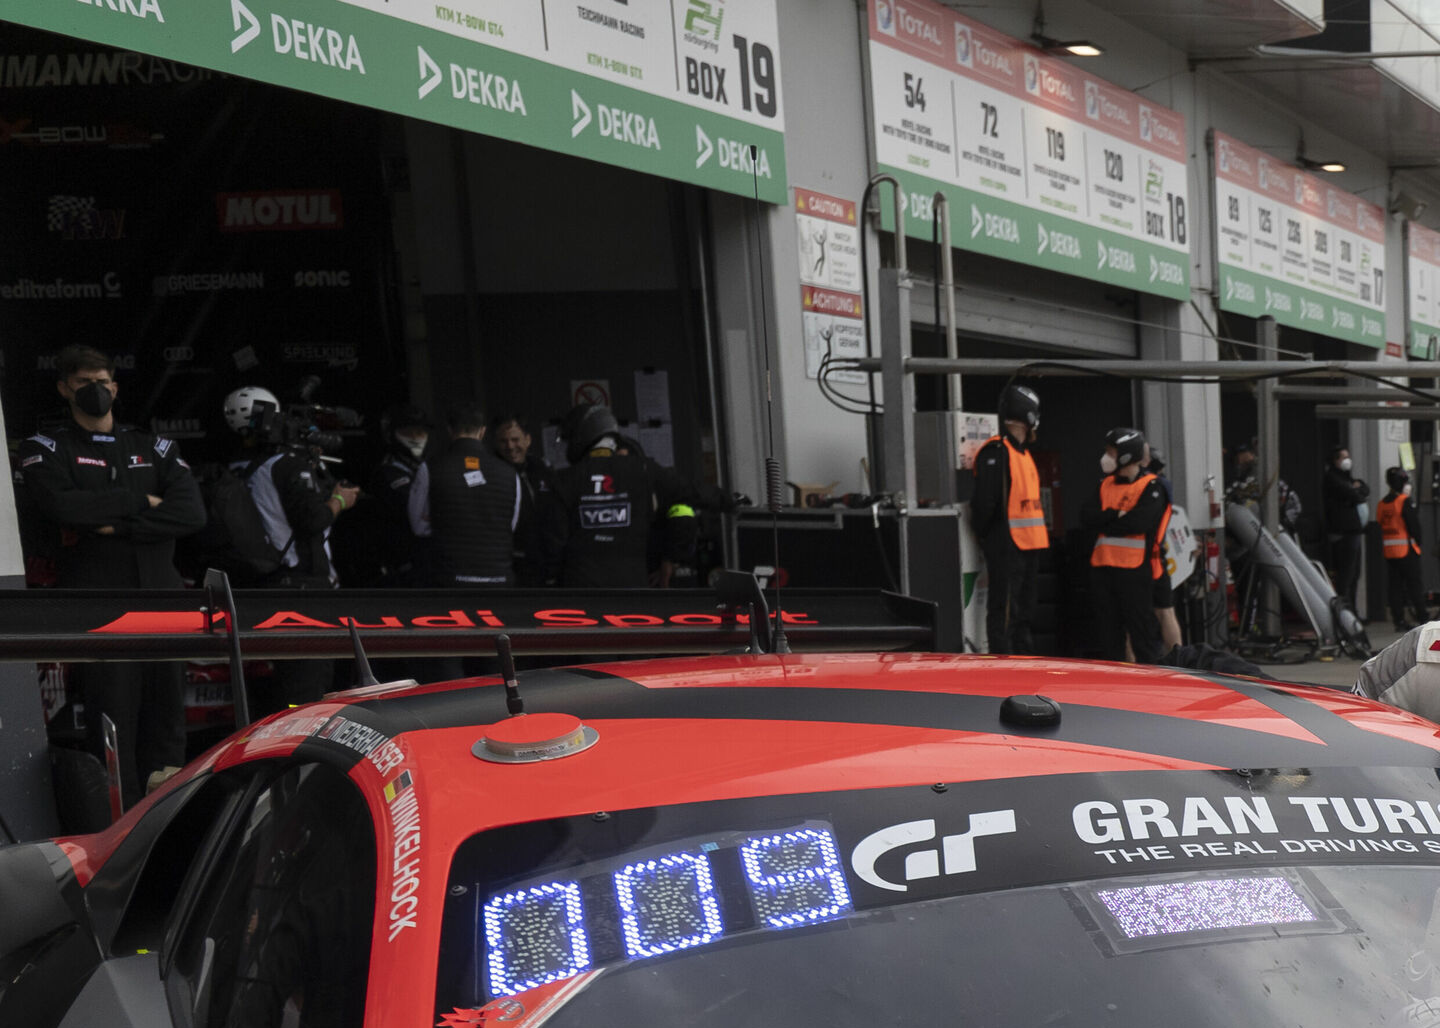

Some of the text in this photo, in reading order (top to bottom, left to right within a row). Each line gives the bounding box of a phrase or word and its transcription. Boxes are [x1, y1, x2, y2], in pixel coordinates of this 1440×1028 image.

[577, 6, 645, 39] TEICHMANN RACING
[896, 6, 942, 46] TOTAL
[270, 13, 366, 75] DEKRA
[973, 40, 1013, 76] TOTAL
[450, 62, 527, 116] DEKRA
[685, 33, 777, 118] BOX 19
[904, 72, 926, 112] 54
[1039, 69, 1075, 102] TOTAL
[980, 102, 998, 139] 72
[1100, 94, 1131, 125] TOTAL
[597, 104, 661, 150] DEKRA
[1150, 116, 1180, 146] TOTAL
[718, 137, 772, 179] DEKRA
[1046, 127, 1065, 162] 119
[1104, 149, 1123, 182] 120
[224, 194, 337, 227] MOTUL
[809, 196, 844, 218] CAUTION
[910, 192, 936, 222] DEK
[1146, 211, 1164, 239] BOX
[1166, 192, 1187, 245] 18
[984, 213, 1020, 244] DEKRA
[1050, 230, 1082, 260] DEKRA
[1107, 246, 1136, 273] DEKRA
[1158, 261, 1184, 286] DEKRA
[294, 269, 351, 288] sonic
[812, 291, 854, 313] ACHTUNG
[584, 507, 627, 524] YCM
[252, 609, 505, 630] Audi
[1072, 796, 1278, 845] GRAN
[388, 787, 421, 944] WINKELHOCK
[1094, 844, 1178, 864] THE
[1182, 839, 1283, 859] REAL
[1288, 836, 1419, 856] DRIVING
